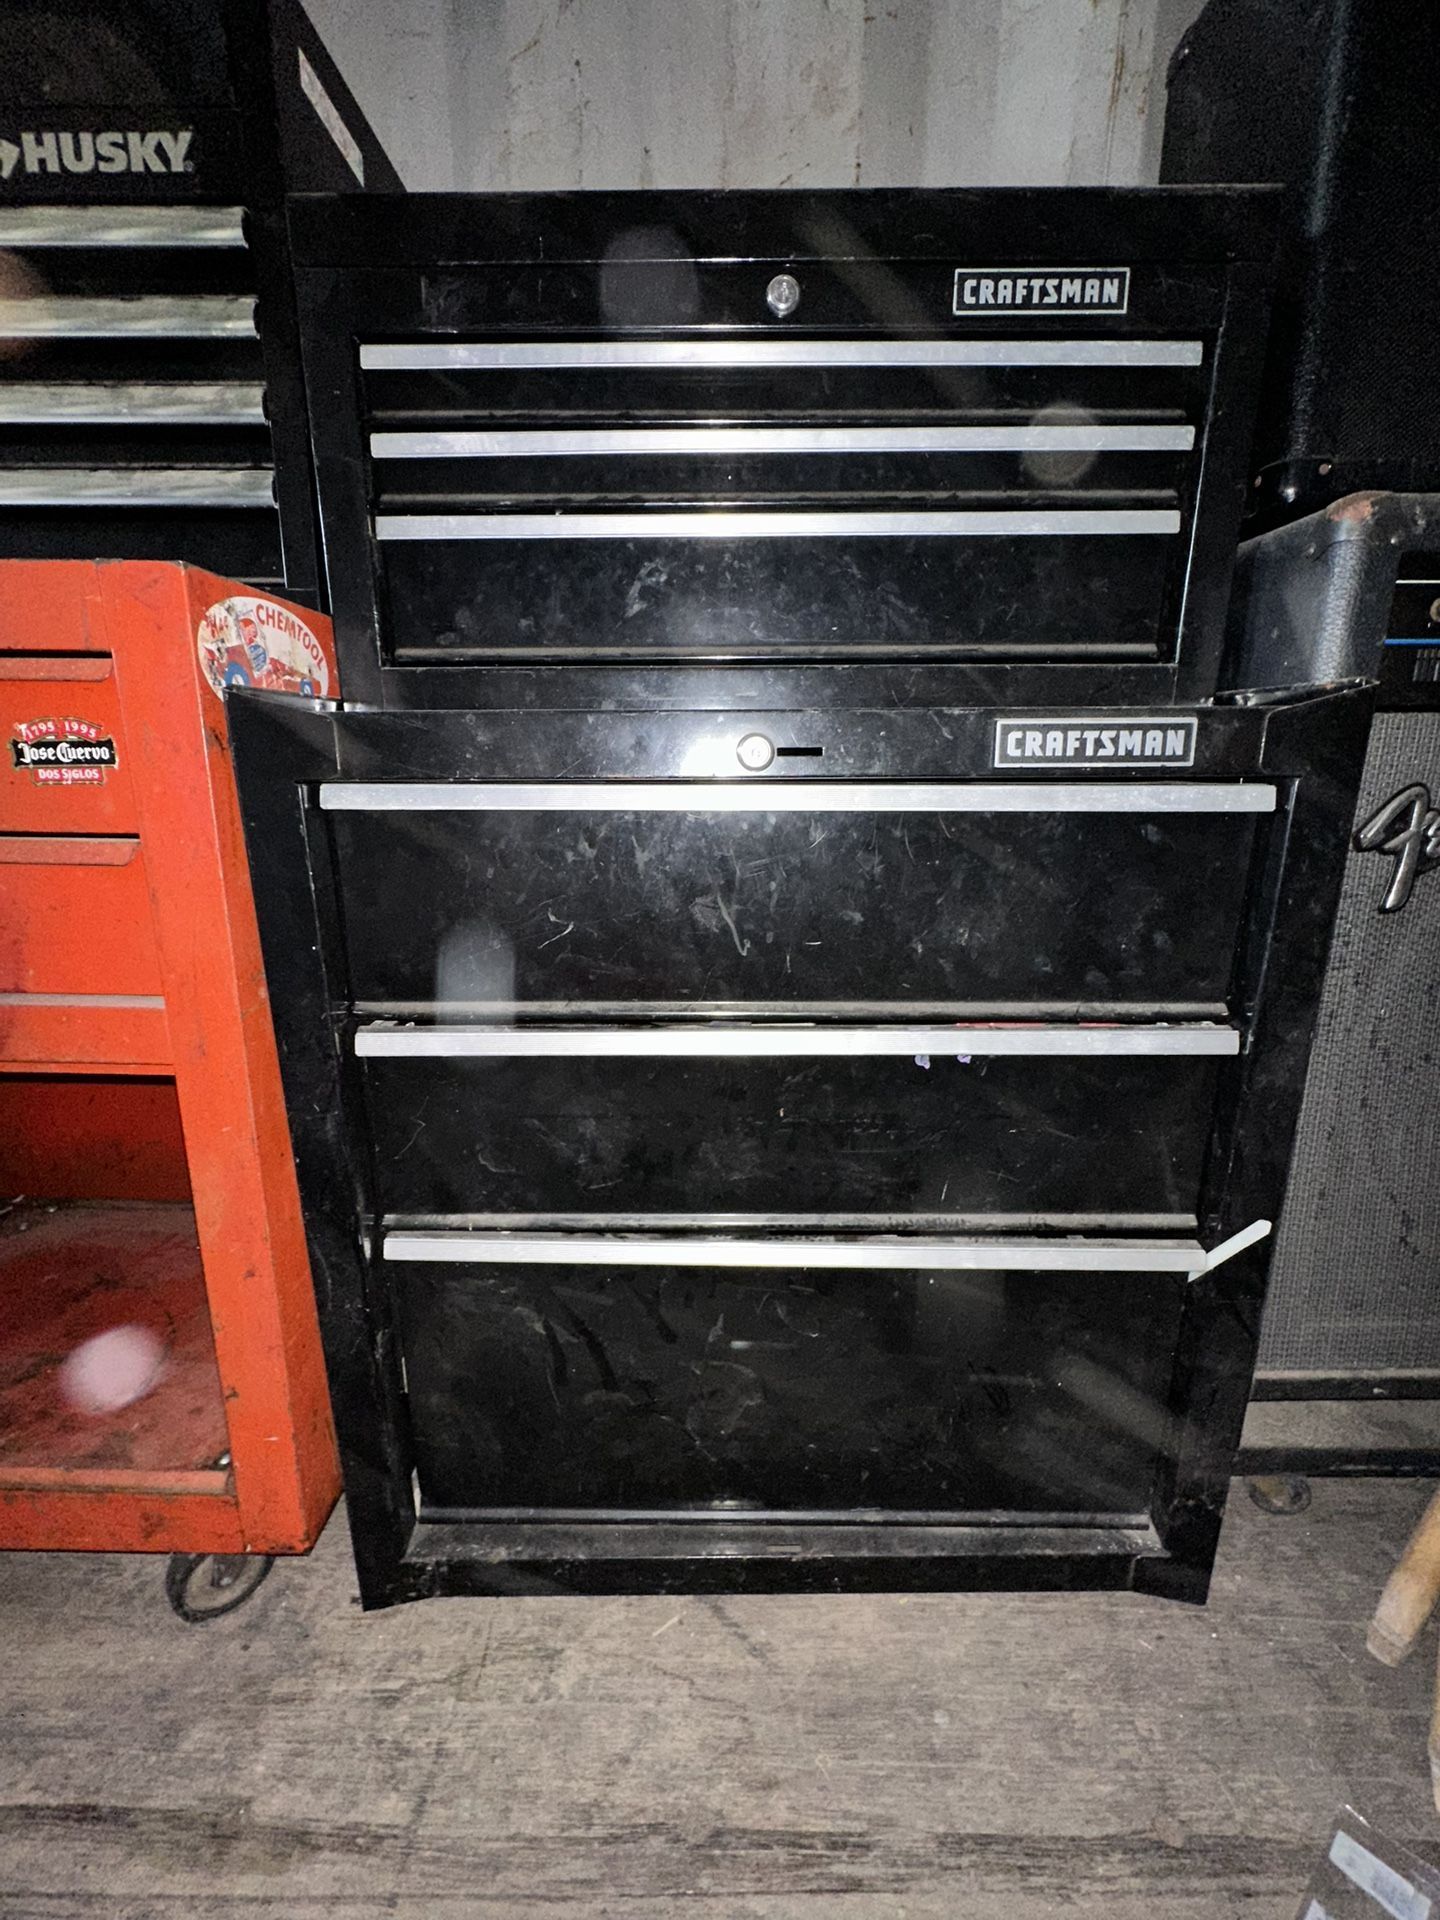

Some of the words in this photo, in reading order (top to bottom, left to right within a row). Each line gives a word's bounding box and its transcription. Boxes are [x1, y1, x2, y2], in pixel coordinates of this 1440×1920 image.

[963, 278, 1120, 305] CRAFTSMAN
[255, 603, 325, 671] CHEMTOOL
[64, 721, 97, 738] 1995
[56, 742, 110, 763] Cuervo
[1007, 729, 1186, 757] CRAFTSMAN
[38, 768, 61, 779] DOS
